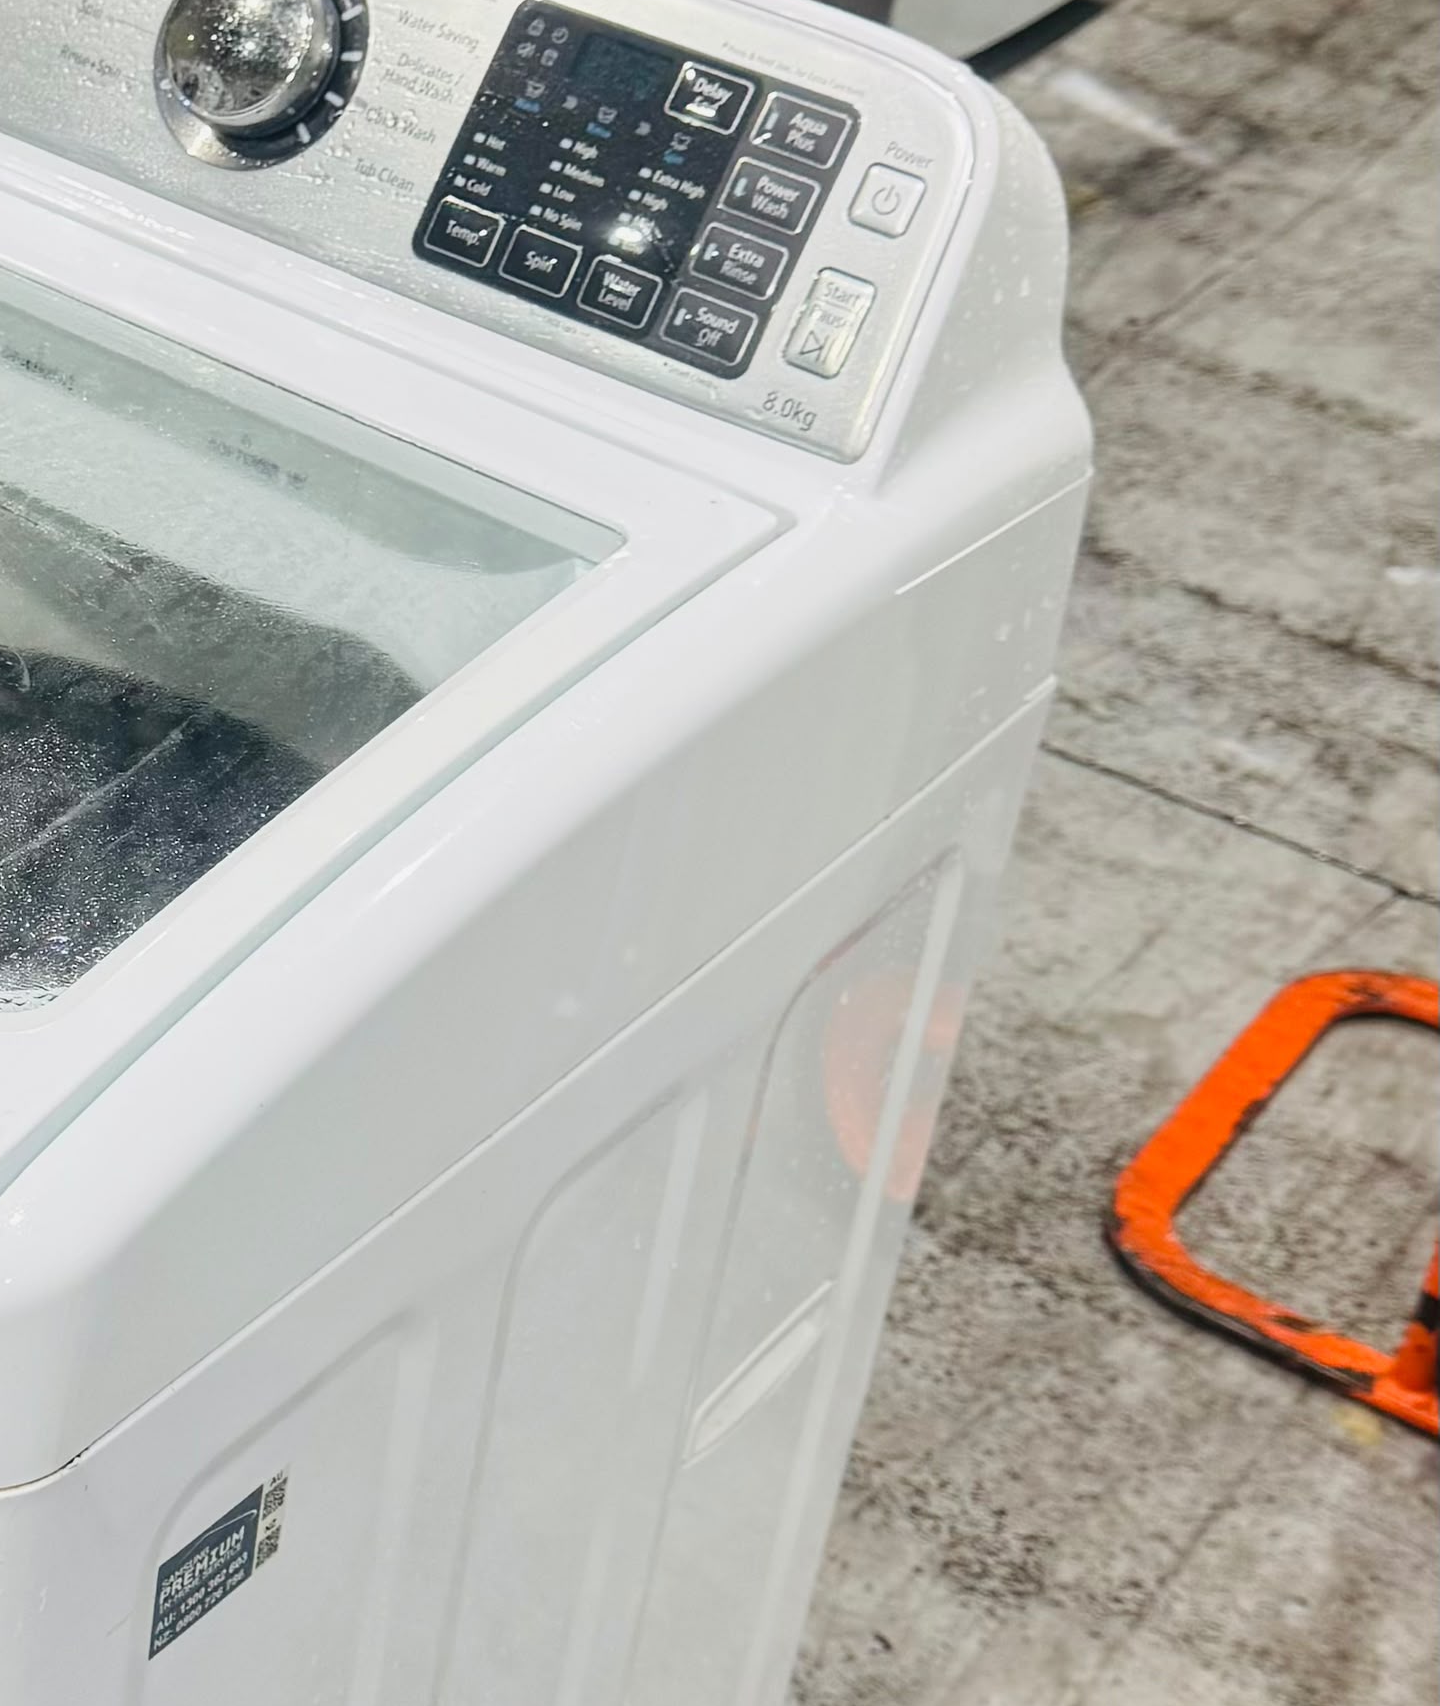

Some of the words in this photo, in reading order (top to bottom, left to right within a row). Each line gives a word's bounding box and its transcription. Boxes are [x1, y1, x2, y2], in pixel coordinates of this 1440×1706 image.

[397, 10, 436, 35] Water
[437, 22, 479, 48] Saving
[380, 68, 418, 93] Hand
[693, 78, 733, 104] Delay
[789, 112, 828, 137] Aqua
[785, 130, 816, 153] Plus
[884, 140, 935, 169] Power
[354, 158, 376, 177] Tub
[378, 167, 415, 192] Clean
[466, 179, 492, 196] Cold
[755, 175, 800, 202] Power
[751, 195, 789, 220] Wash
[524, 251, 553, 273] Spin
[728, 243, 765, 268] Extra
[720, 260, 758, 285] Rinse
[598, 289, 635, 312] Level
[823, 282, 862, 306] Start
[695, 307, 740, 334] Sound
[698, 327, 724, 348] Off
[762, 391, 818, 432] 8.0kg
[269, 1469, 283, 1487] AU
[159, 1525, 244, 1604] PREMIUM
[155, 1609, 175, 1634] AU:
